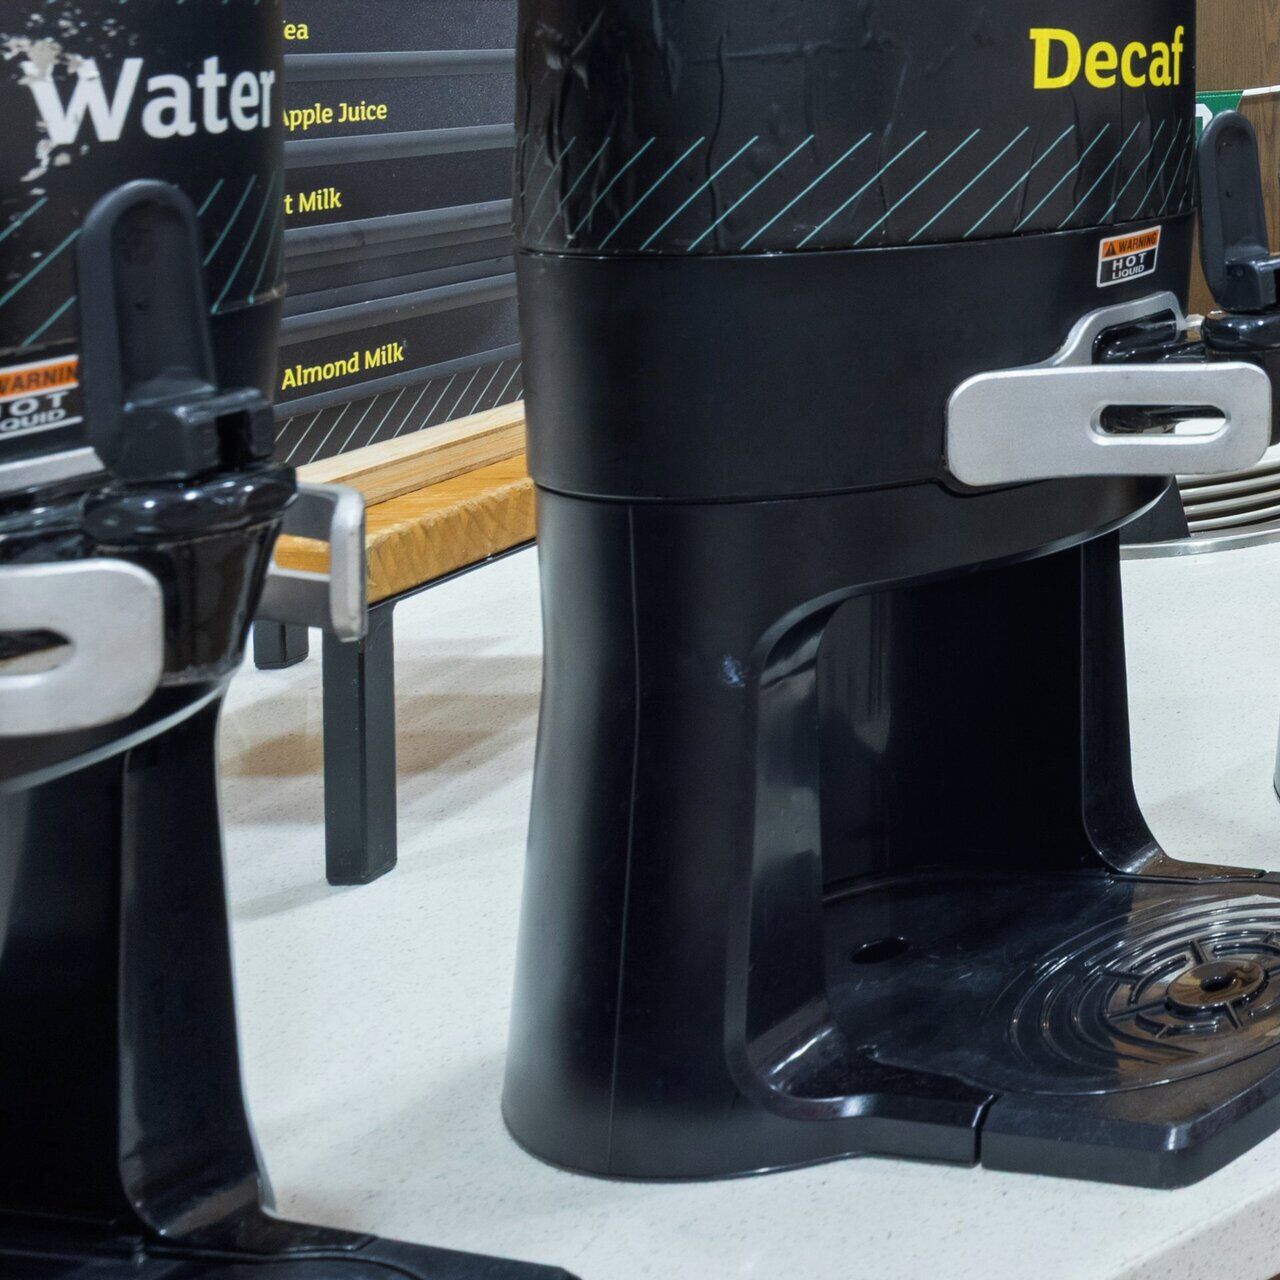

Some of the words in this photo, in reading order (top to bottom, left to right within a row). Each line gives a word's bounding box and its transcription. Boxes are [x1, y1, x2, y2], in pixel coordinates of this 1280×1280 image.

[283, 23, 309, 40] ea
[1029, 25, 1185, 90] Decaf
[22, 56, 275, 144] Water
[338, 101, 388, 122] Juice
[299, 187, 342, 213] Milk
[1119, 232, 1157, 252] WARNING
[1112, 252, 1147, 271] HOT
[1112, 264, 1145, 280] LIQUID
[281, 352, 359, 390] Almond
[364, 342, 405, 370] Milk
[0, 365, 77, 394] ARNIN
[0, 390, 69, 417] OT
[0, 408, 66, 431] QUID
